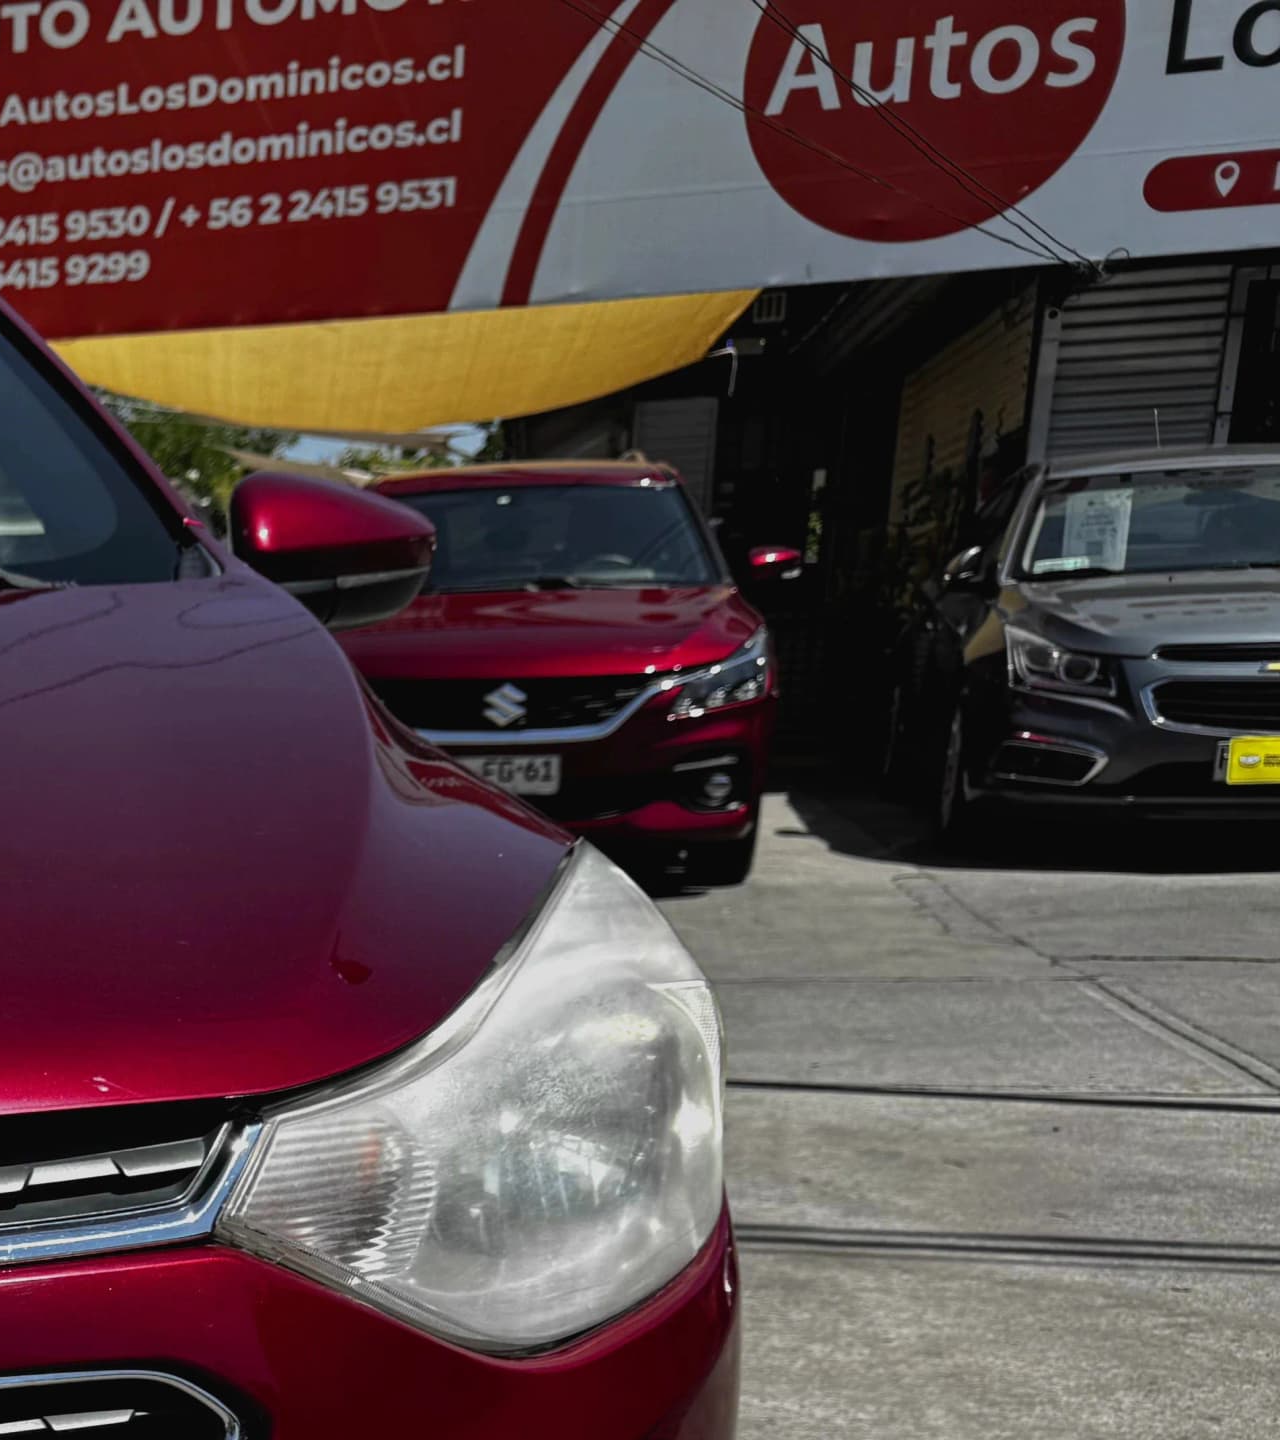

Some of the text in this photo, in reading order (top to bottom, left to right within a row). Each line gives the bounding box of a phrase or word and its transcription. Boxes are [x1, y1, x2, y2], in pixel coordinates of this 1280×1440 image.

[106, 0, 443, 43] AUTO
[764, 15, 1098, 117] Autos
[65, 205, 151, 242] 9530
[206, 196, 253, 230] 56
[258, 192, 282, 225] 2
[288, 185, 370, 221] 2415
[375, 176, 458, 213] 9531
[65, 248, 151, 286] 9299
